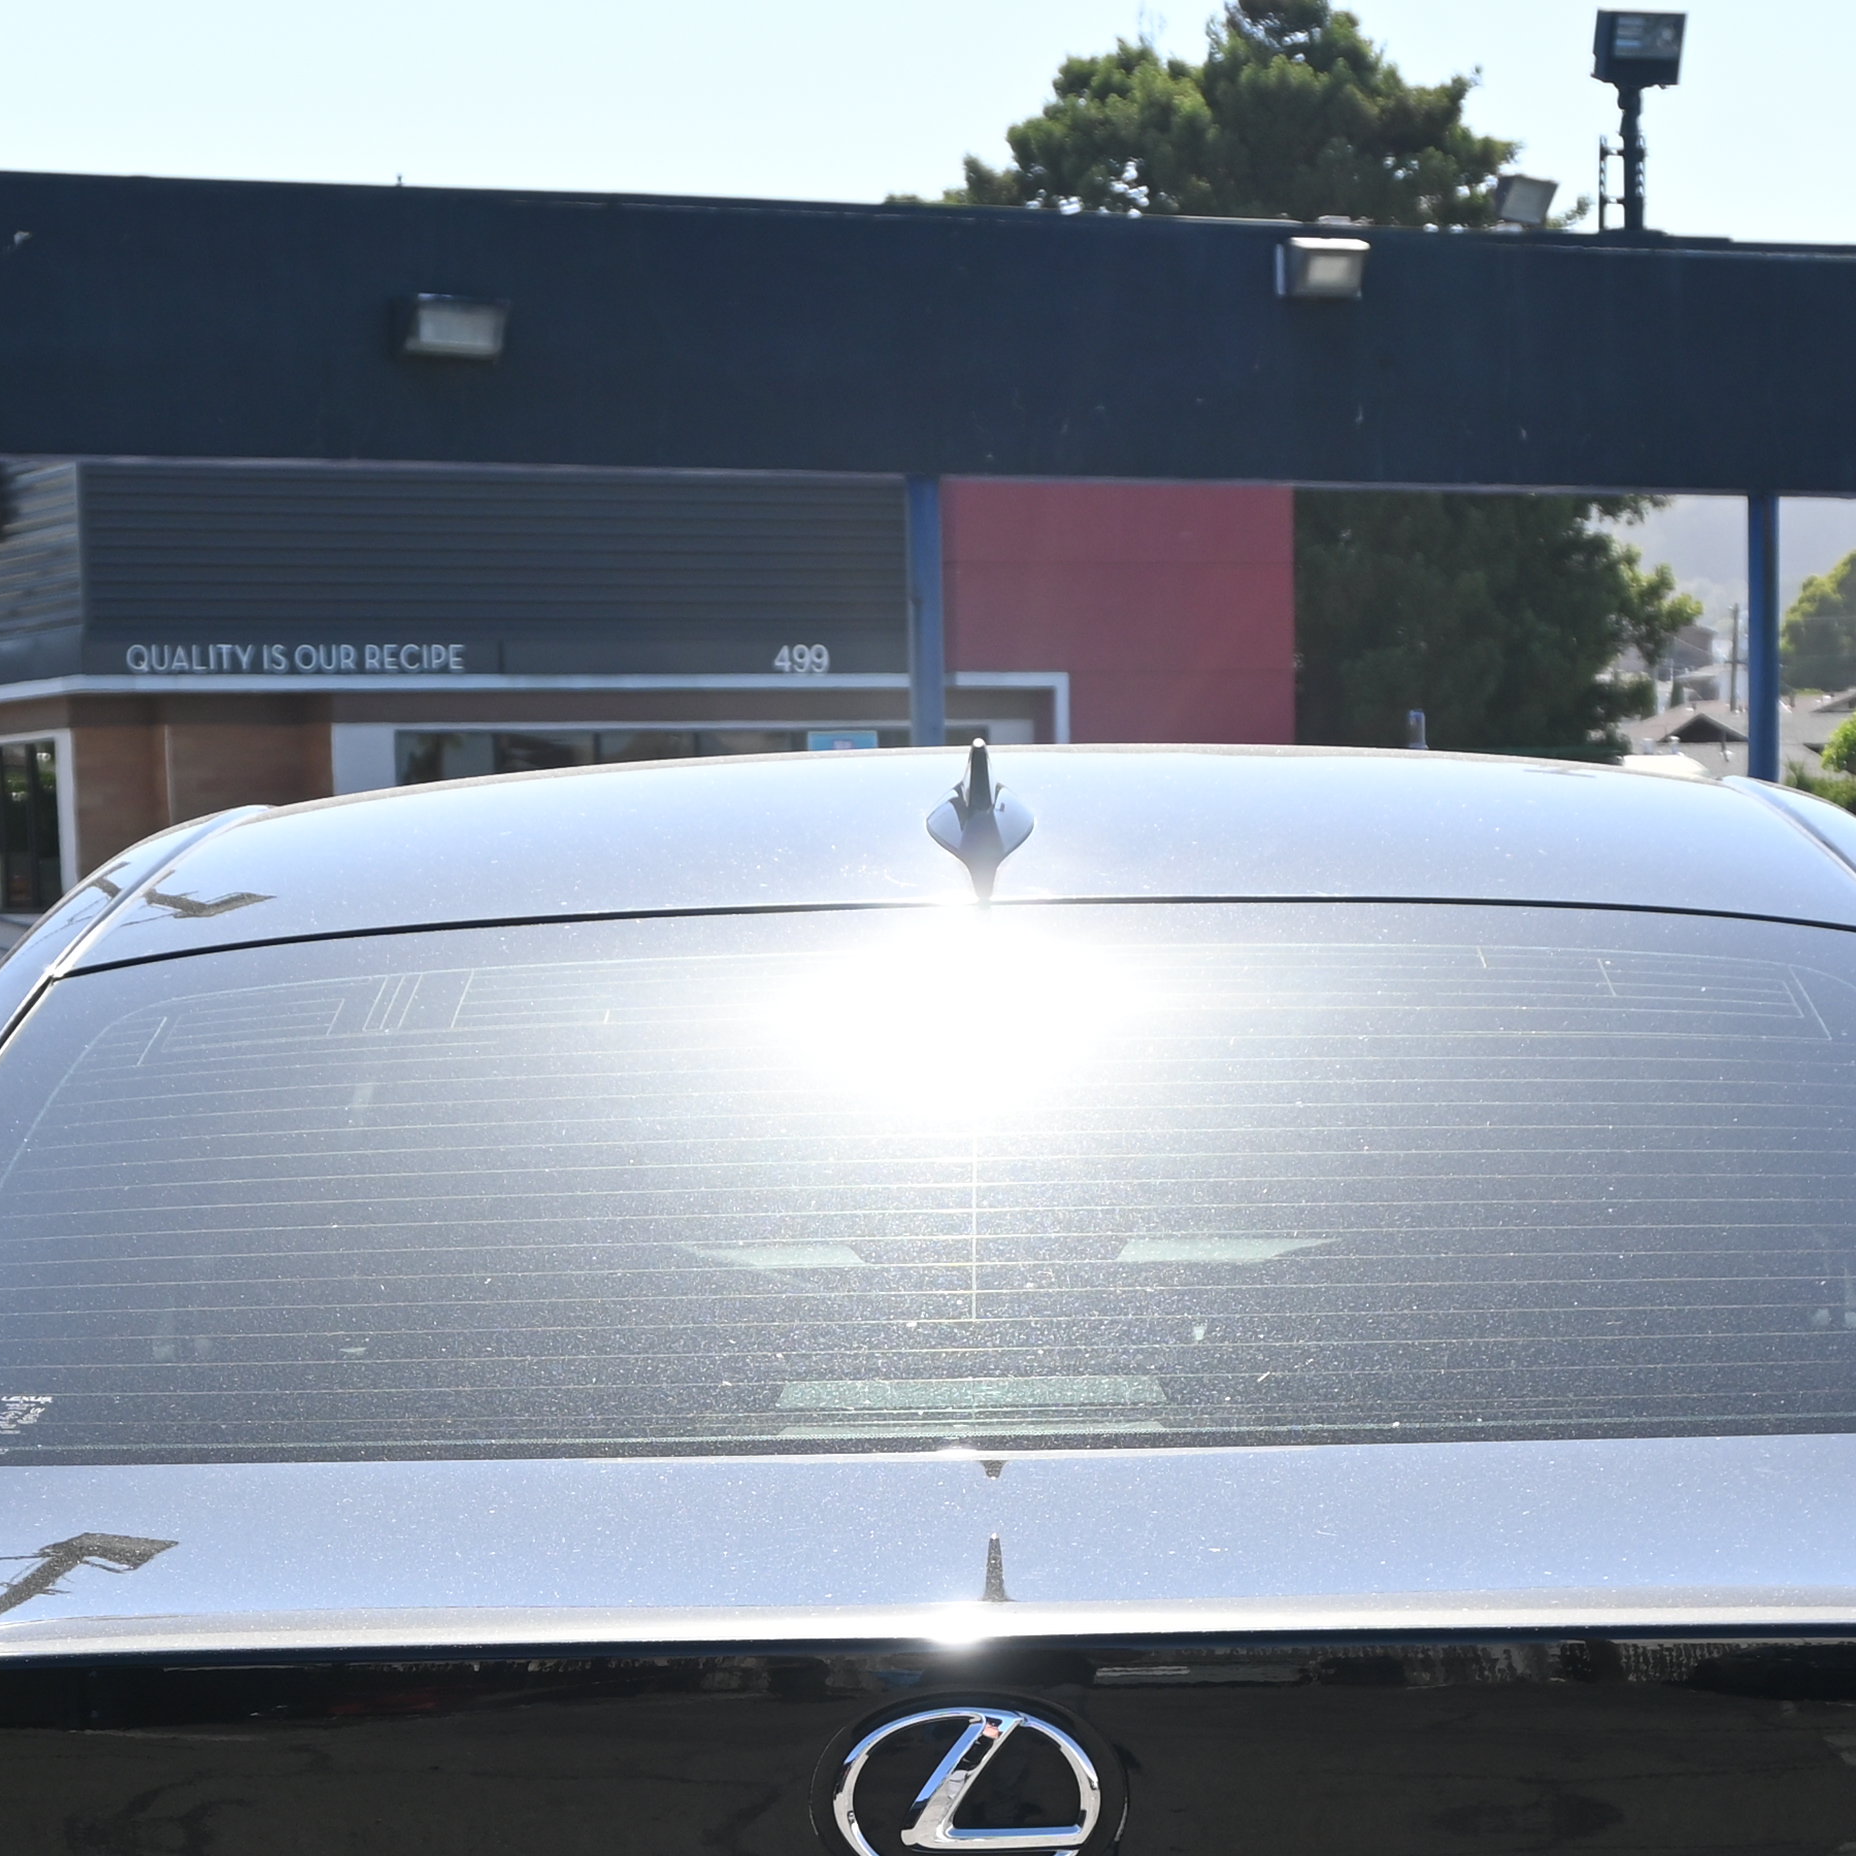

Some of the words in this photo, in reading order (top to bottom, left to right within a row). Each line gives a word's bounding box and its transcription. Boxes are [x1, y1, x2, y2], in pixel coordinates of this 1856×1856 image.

[126, 643, 253, 674] QUALITY
[262, 643, 289, 671] IS
[294, 643, 357, 671] OUR
[364, 643, 466, 671] RECIPE
[773, 643, 830, 673] 499
